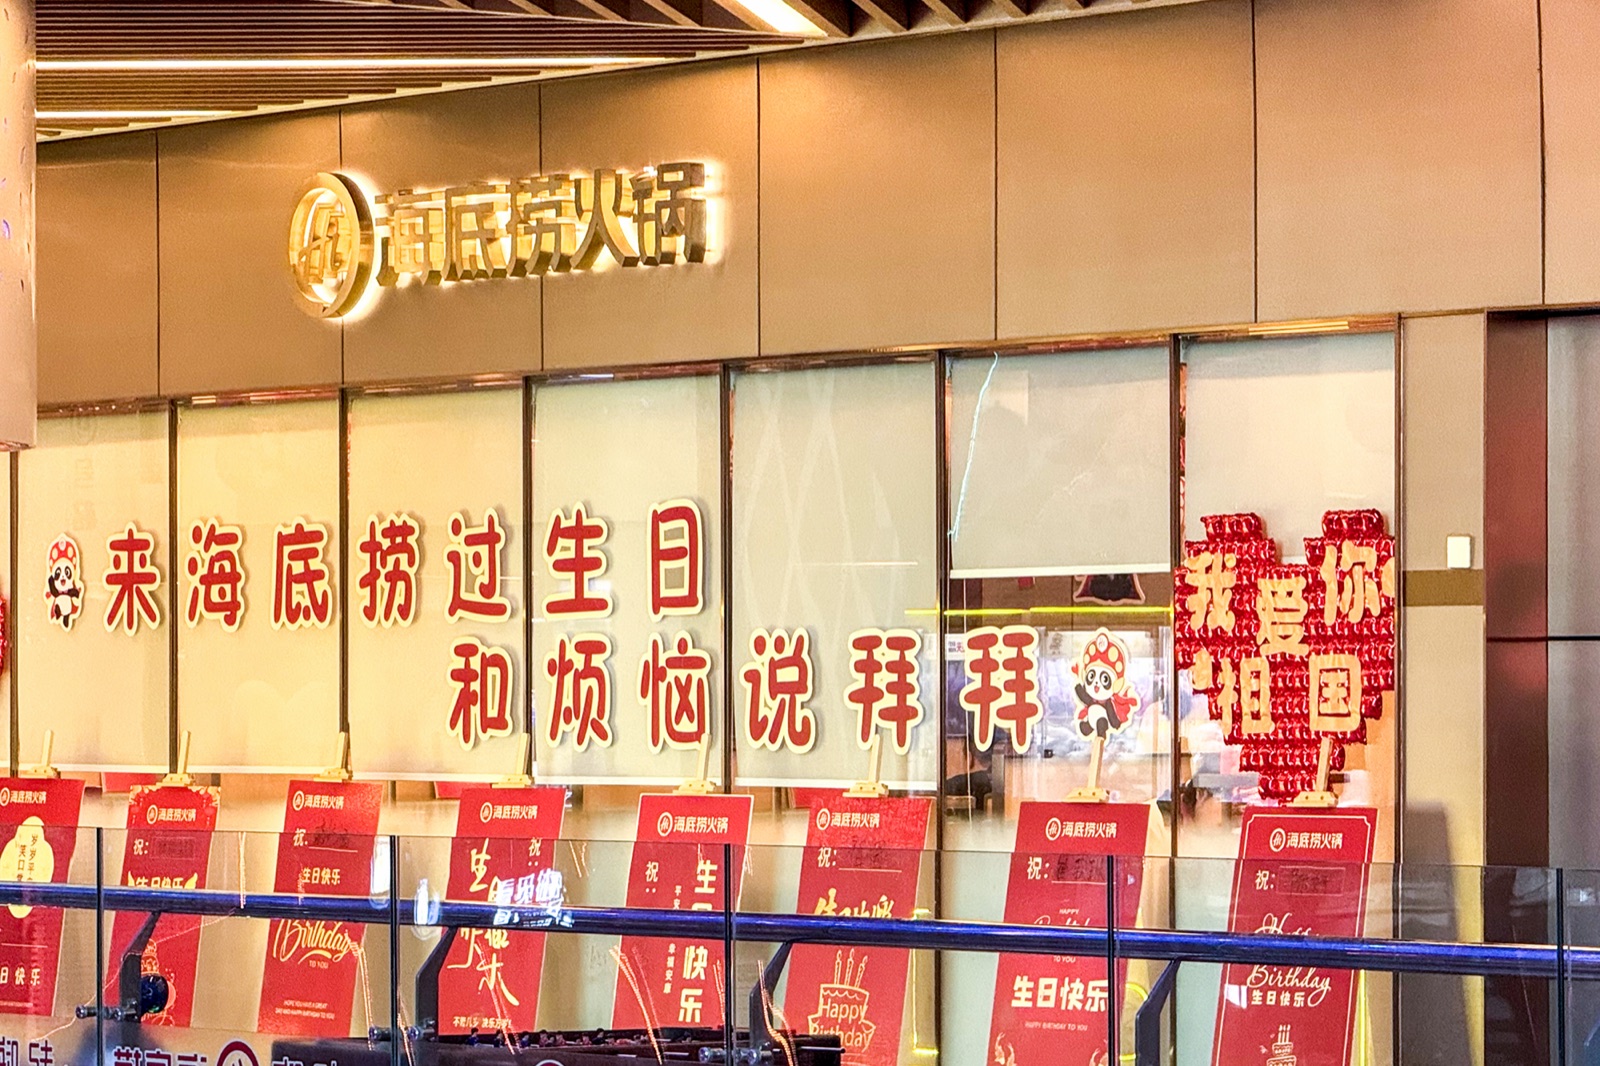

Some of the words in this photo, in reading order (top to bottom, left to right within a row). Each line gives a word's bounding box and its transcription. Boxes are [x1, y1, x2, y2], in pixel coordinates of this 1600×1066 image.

[375, 163, 705, 286] 海底捞火锅
[104, 504, 701, 631] 来海底捞过生日
[449, 631, 1038, 748] 和烦恼说拜拜
[10, 790, 47, 804] 海底捞火锅
[304, 794, 344, 810] 海底捞火锅
[157, 808, 197, 822] 海底捞火锅
[493, 805, 538, 820] 海底捞火锅
[831, 812, 880, 828] 海底捞火锅
[673, 816, 729, 834] 海底捞火锅
[1062, 821, 1117, 838] 海底捞火锅
[1286, 832, 1343, 849] 海底捞火锅
[27, 834, 38, 880] 岁岁平
[302, 867, 341, 885] 生日快乐
[1011, 975, 1108, 1012] 生日快乐
[1247, 965, 1332, 1007] Birthday
[1251, 989, 1305, 1007] 生日快乐
[822, 998, 868, 1024] Happy
